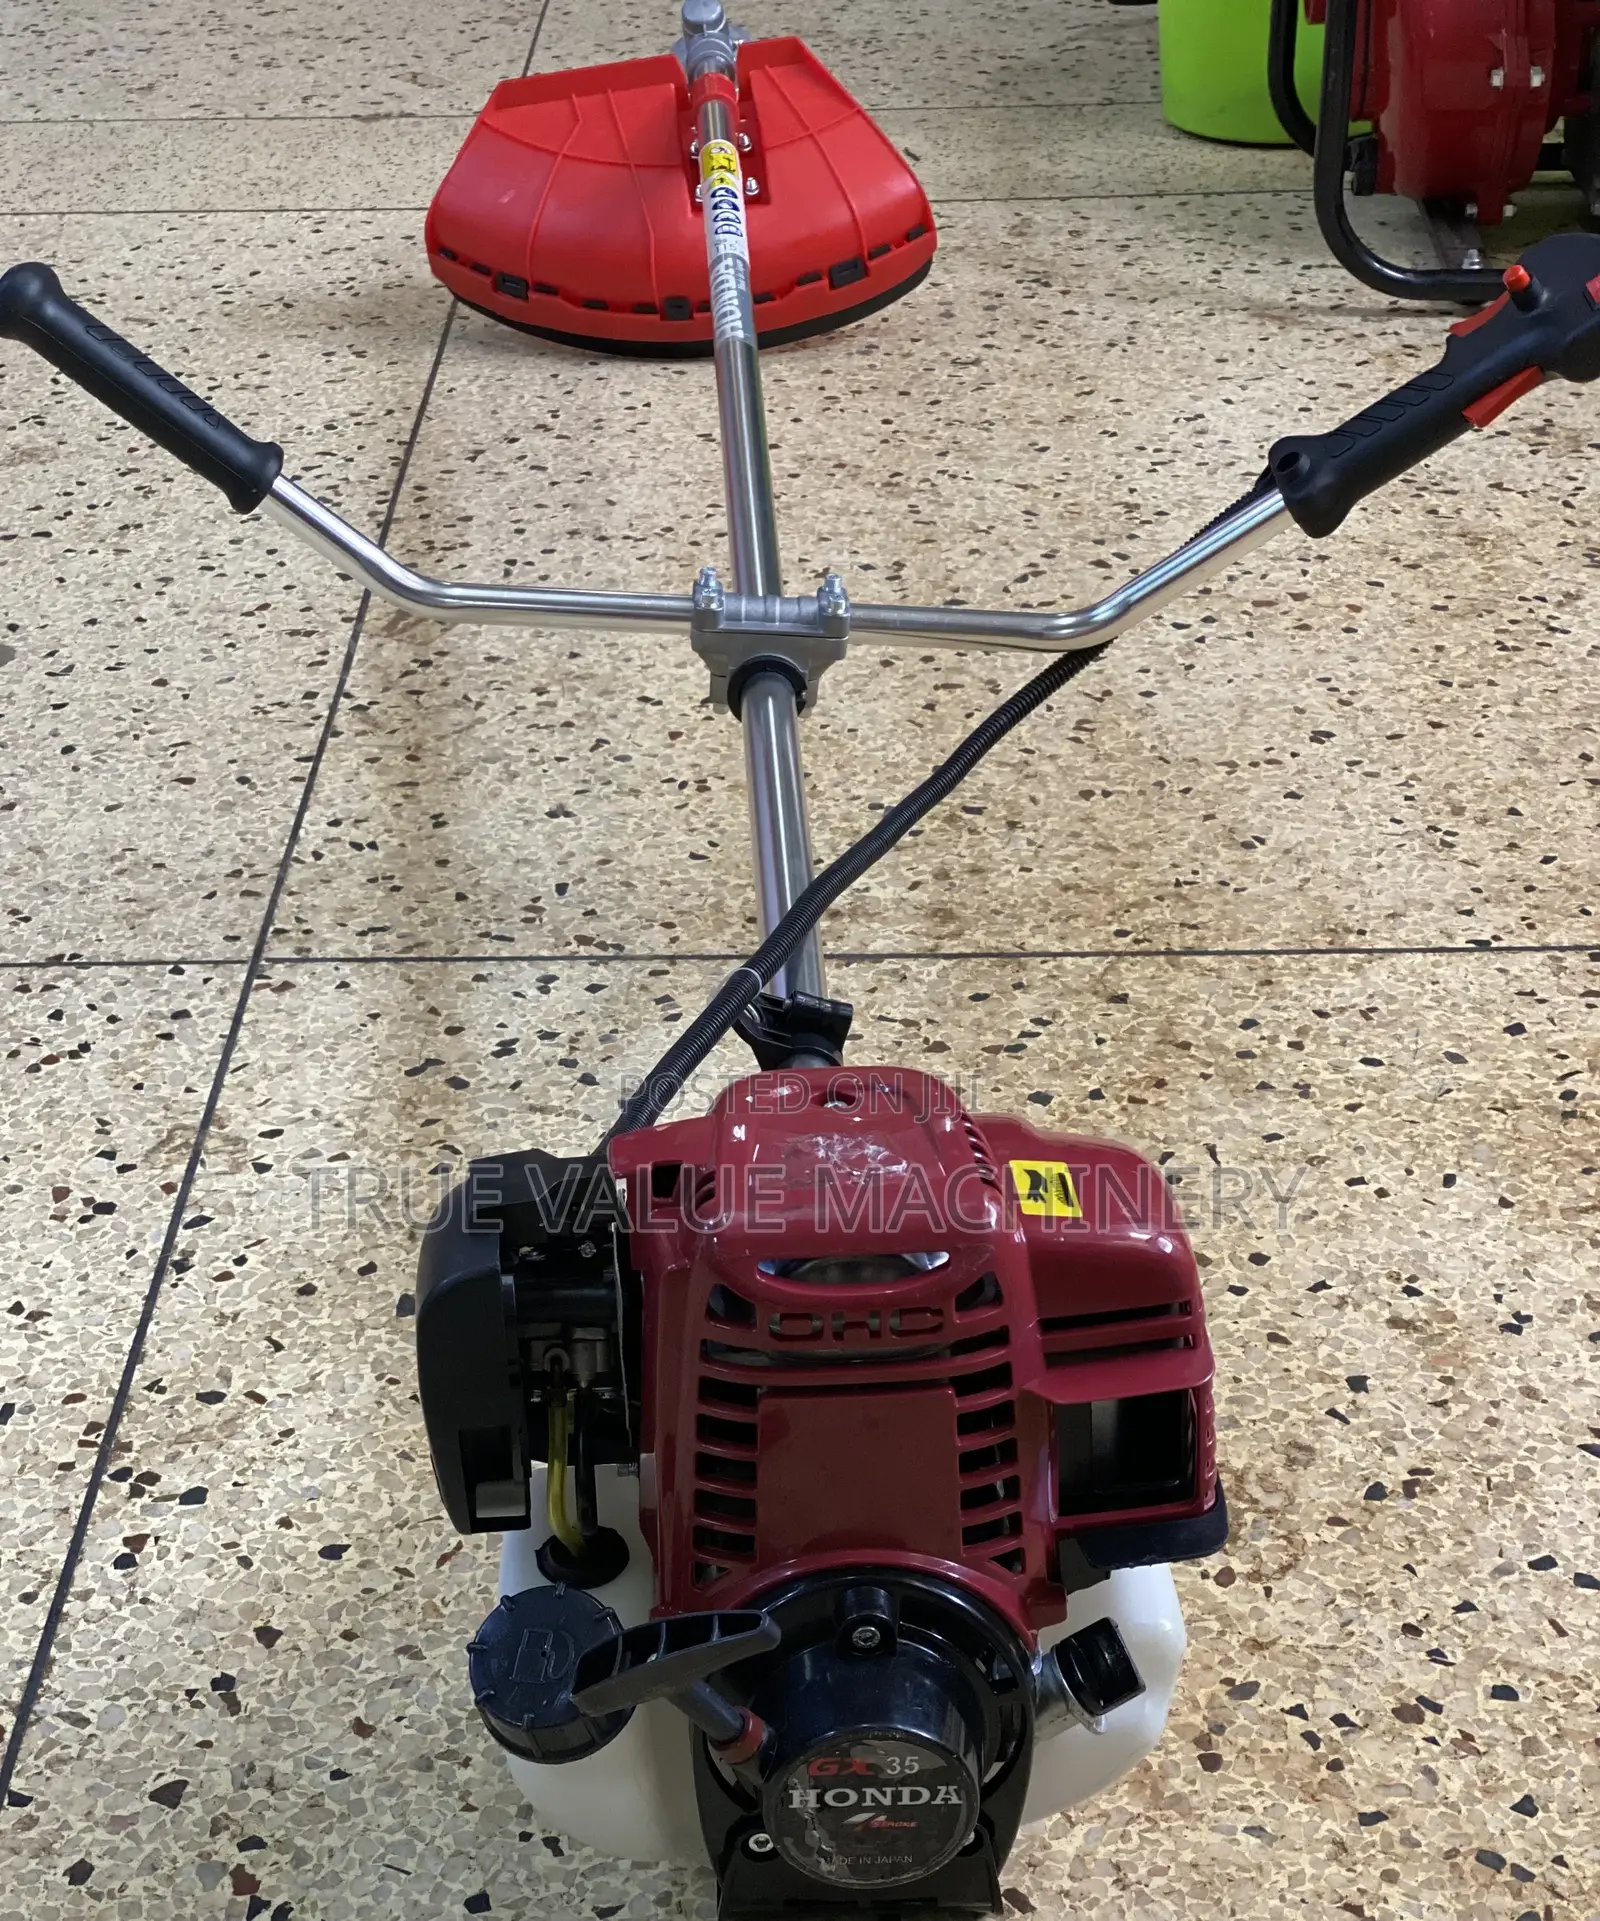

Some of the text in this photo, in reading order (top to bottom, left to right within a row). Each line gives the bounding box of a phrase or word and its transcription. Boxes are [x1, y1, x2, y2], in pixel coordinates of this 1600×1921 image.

[711, 257, 745, 339] HONDA
[769, 1306, 944, 1342] OHC
[808, 1756, 919, 1776] GX 35
[788, 1785, 963, 1809] HONDA
[859, 1856, 871, 1865] IN
[874, 1855, 913, 1864] JAPAN
